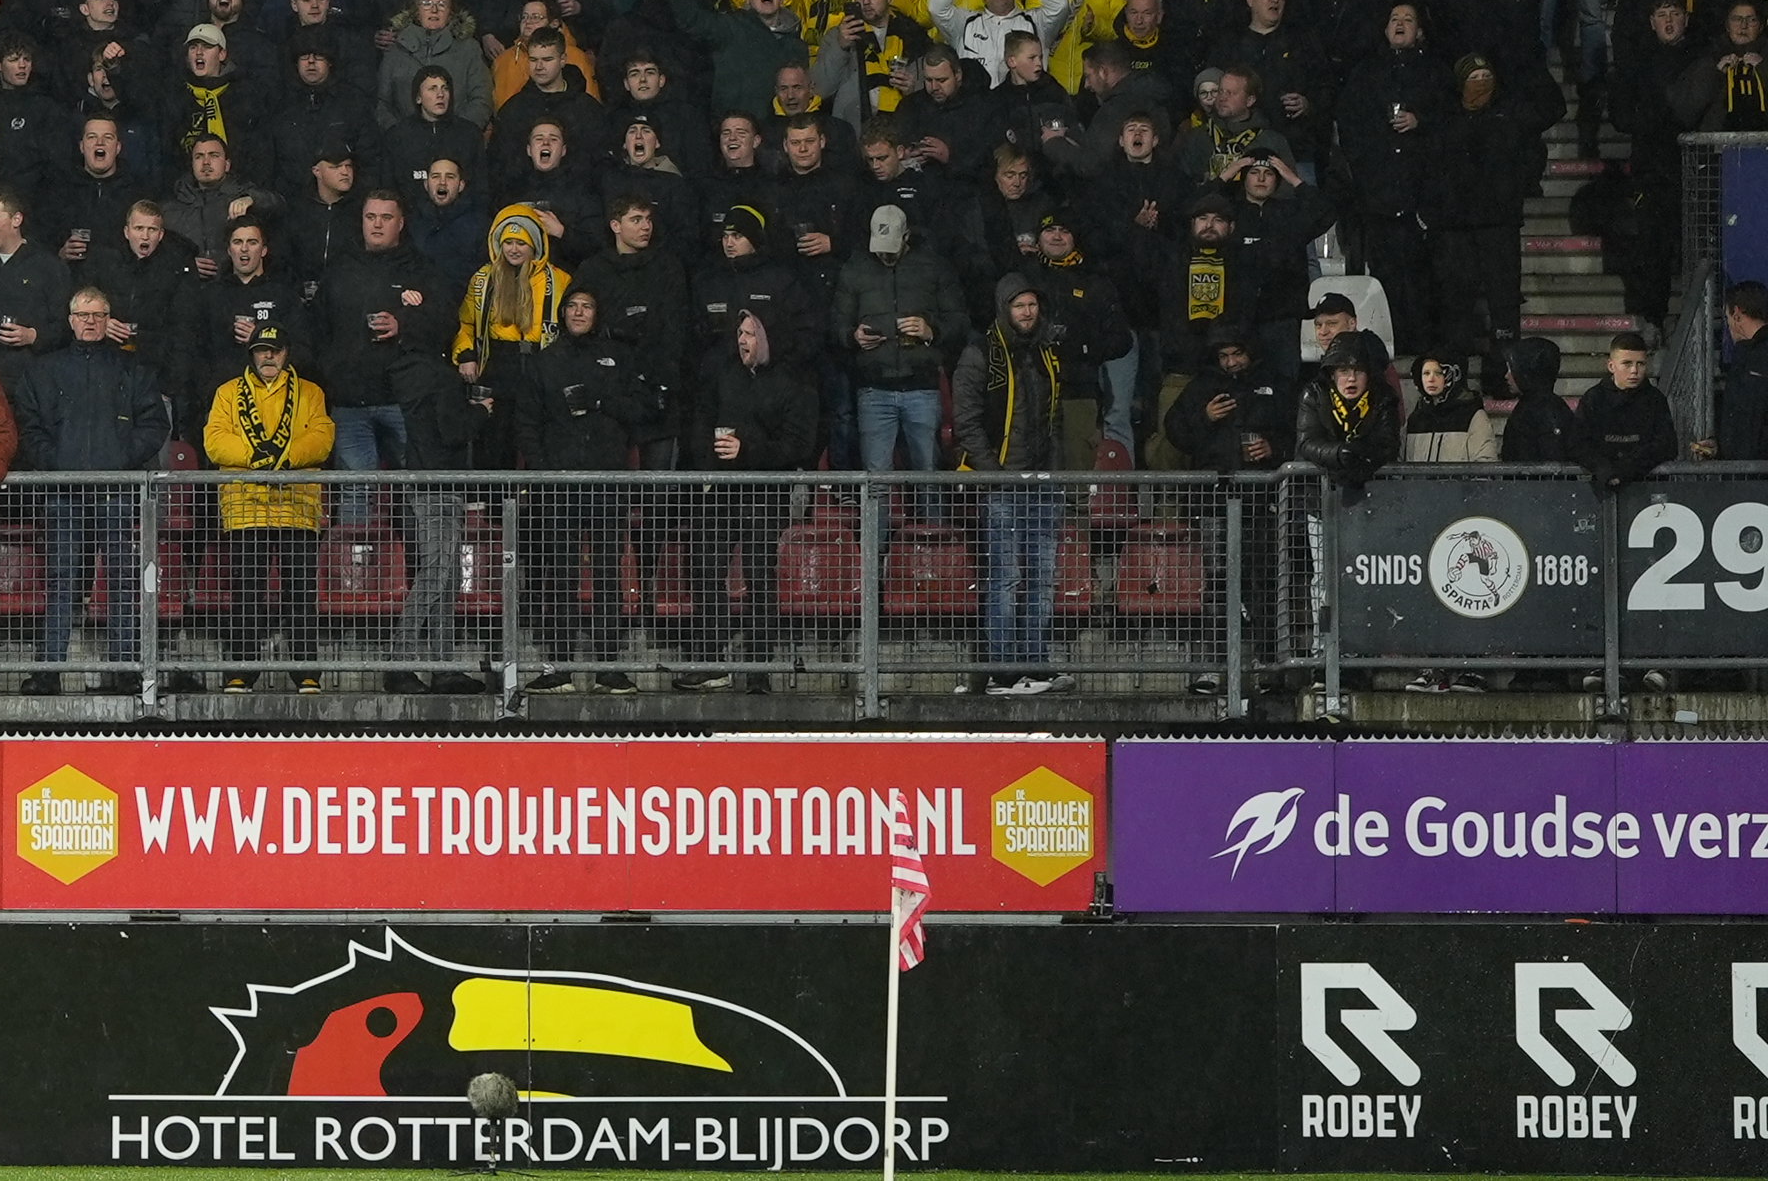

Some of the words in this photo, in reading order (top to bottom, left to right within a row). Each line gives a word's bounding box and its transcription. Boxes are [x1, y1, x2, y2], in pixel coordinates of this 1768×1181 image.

[1192, 274, 1219, 284] NAC
[256, 309, 269, 321] 80
[1355, 555, 1422, 586] SINDS
[1535, 555, 1589, 586] 1888
[1627, 502, 1768, 612] 29
[1441, 583, 1491, 611] SPARTA
[21, 799, 114, 825] BETROKKEN
[135, 786, 977, 857] WWW.DEBETROKKENSPARTAANNL
[995, 800, 1089, 826] BETROKKEN
[1313, 794, 1388, 857] de
[1404, 794, 1640, 859] Goudse
[30, 825, 114, 851] SPARTAAN
[1005, 827, 1089, 853] SPARTAAN
[1302, 1094, 1422, 1139] ROBEY
[1516, 1094, 1637, 1139] ROBEY
[111, 1115, 296, 1161] HOTEL
[316, 1115, 950, 1171] ROTTERDAM-BLIJDORP
